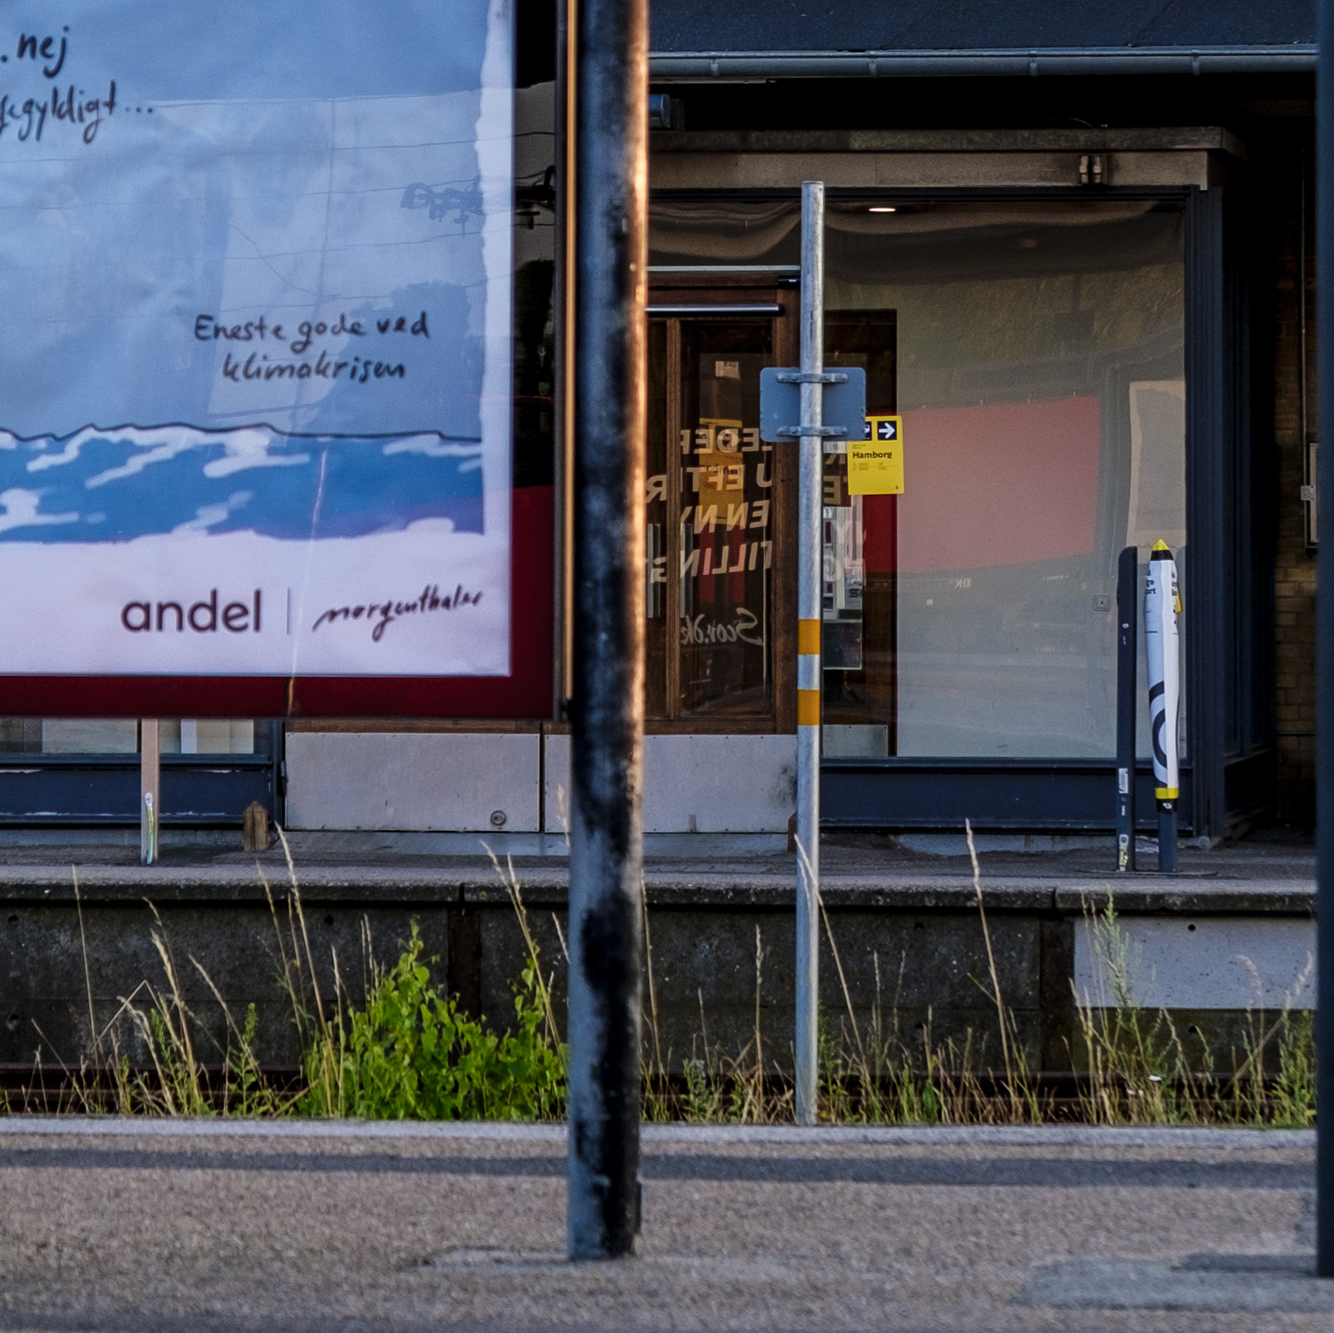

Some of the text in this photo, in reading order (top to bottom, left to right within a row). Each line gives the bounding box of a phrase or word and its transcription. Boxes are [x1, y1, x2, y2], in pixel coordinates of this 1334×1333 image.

[194, 311, 430, 354] Eneste gode ved
[222, 351, 405, 383] klimakrisen
[852, 451, 893, 460] Hamborg
[120, 586, 263, 633] andel
